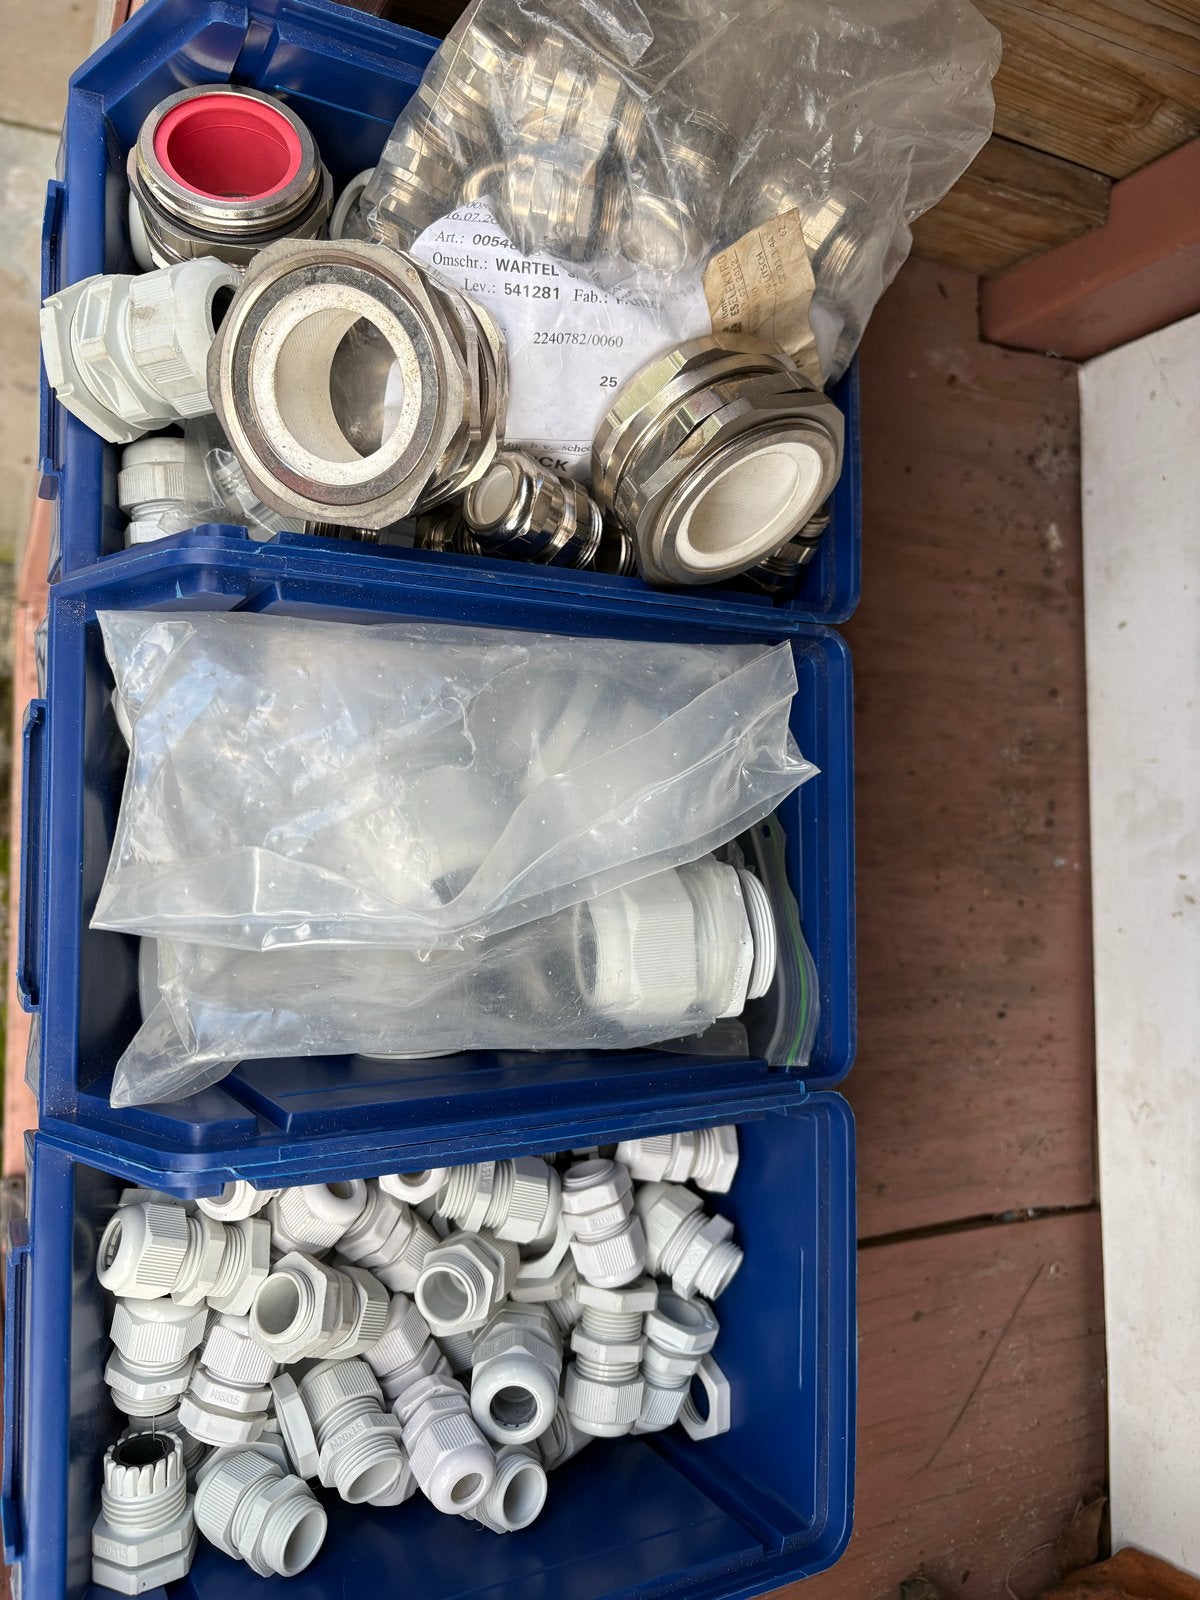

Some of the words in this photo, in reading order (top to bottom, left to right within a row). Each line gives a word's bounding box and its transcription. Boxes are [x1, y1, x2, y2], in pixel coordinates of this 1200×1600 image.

[434, 230, 465, 244] Art.:
[432, 251, 488, 270] Omschr.:
[495, 258, 560, 277] WARTEL
[464, 278, 496, 294] Lev.:
[504, 282, 560, 300] 541281
[574, 288, 608, 304] Fab.:
[533, 332, 623, 348] 2240782/0060
[600, 375, 618, 388] 25
[534, 456, 569, 472] CK
